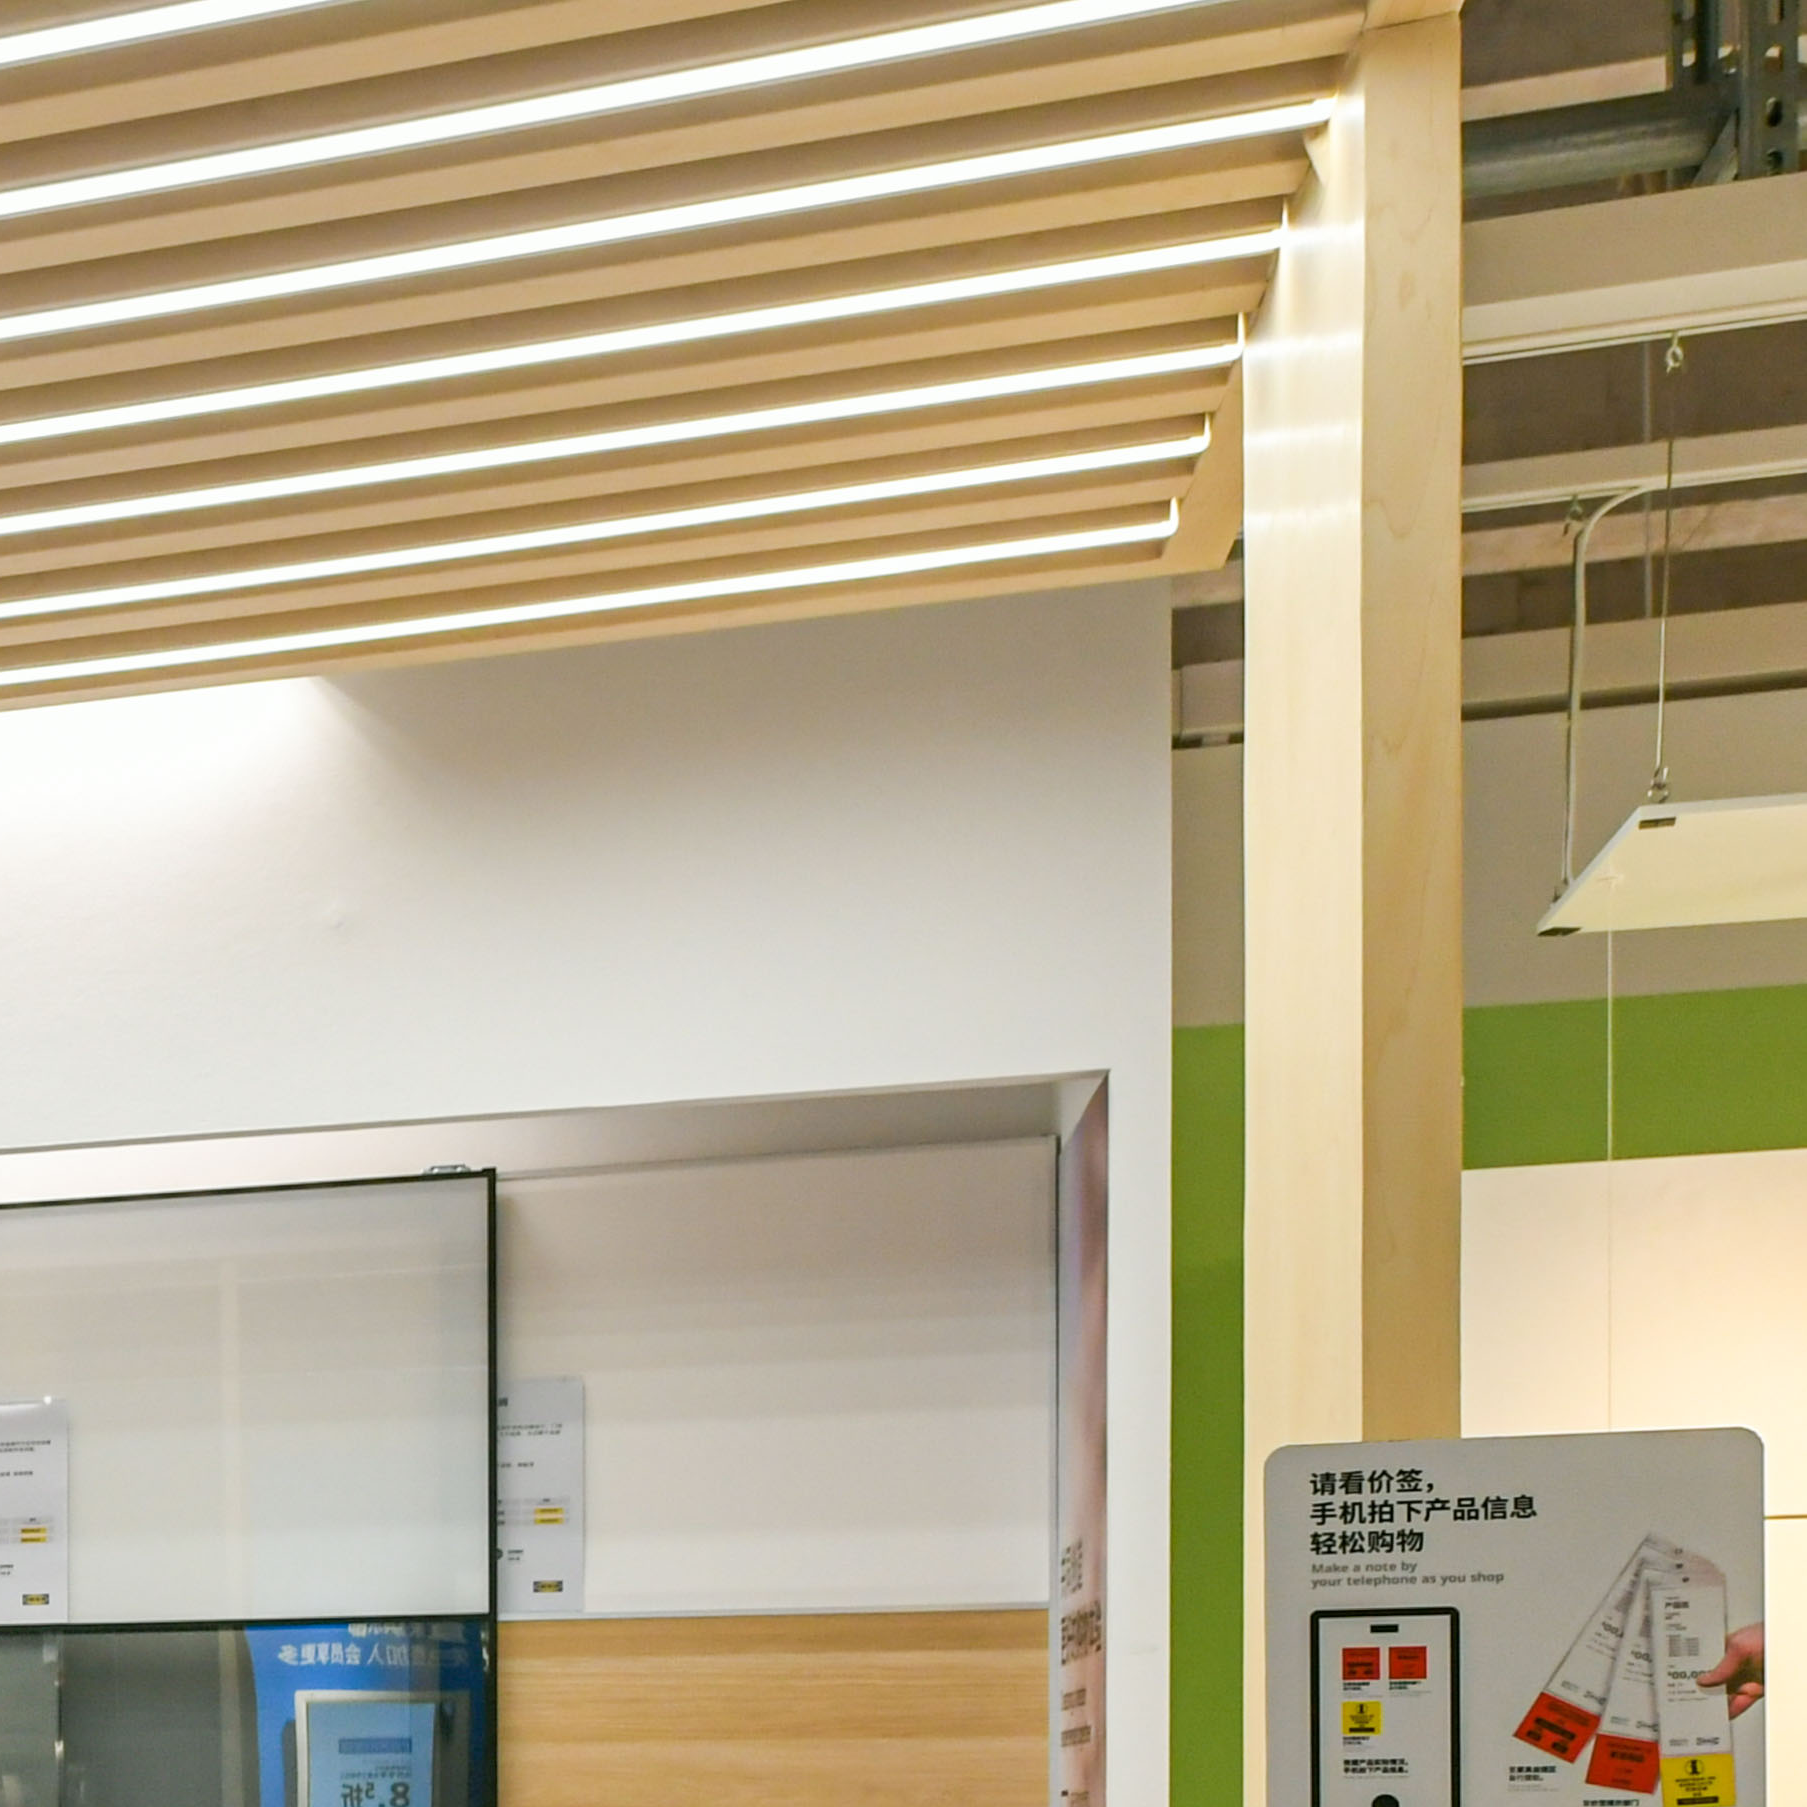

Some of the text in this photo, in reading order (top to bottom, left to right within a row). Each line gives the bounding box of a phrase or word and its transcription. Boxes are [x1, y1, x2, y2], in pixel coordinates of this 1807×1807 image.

[1310, 1468, 1435, 1496] 请看价签，
[1310, 1494, 1538, 1526] 手机拍下产品信息
[1310, 1529, 1425, 1556] 轻松购物
[1311, 1560, 1417, 1574] Make a note by
[1311, 1571, 1504, 1590] your telephone as you shop
